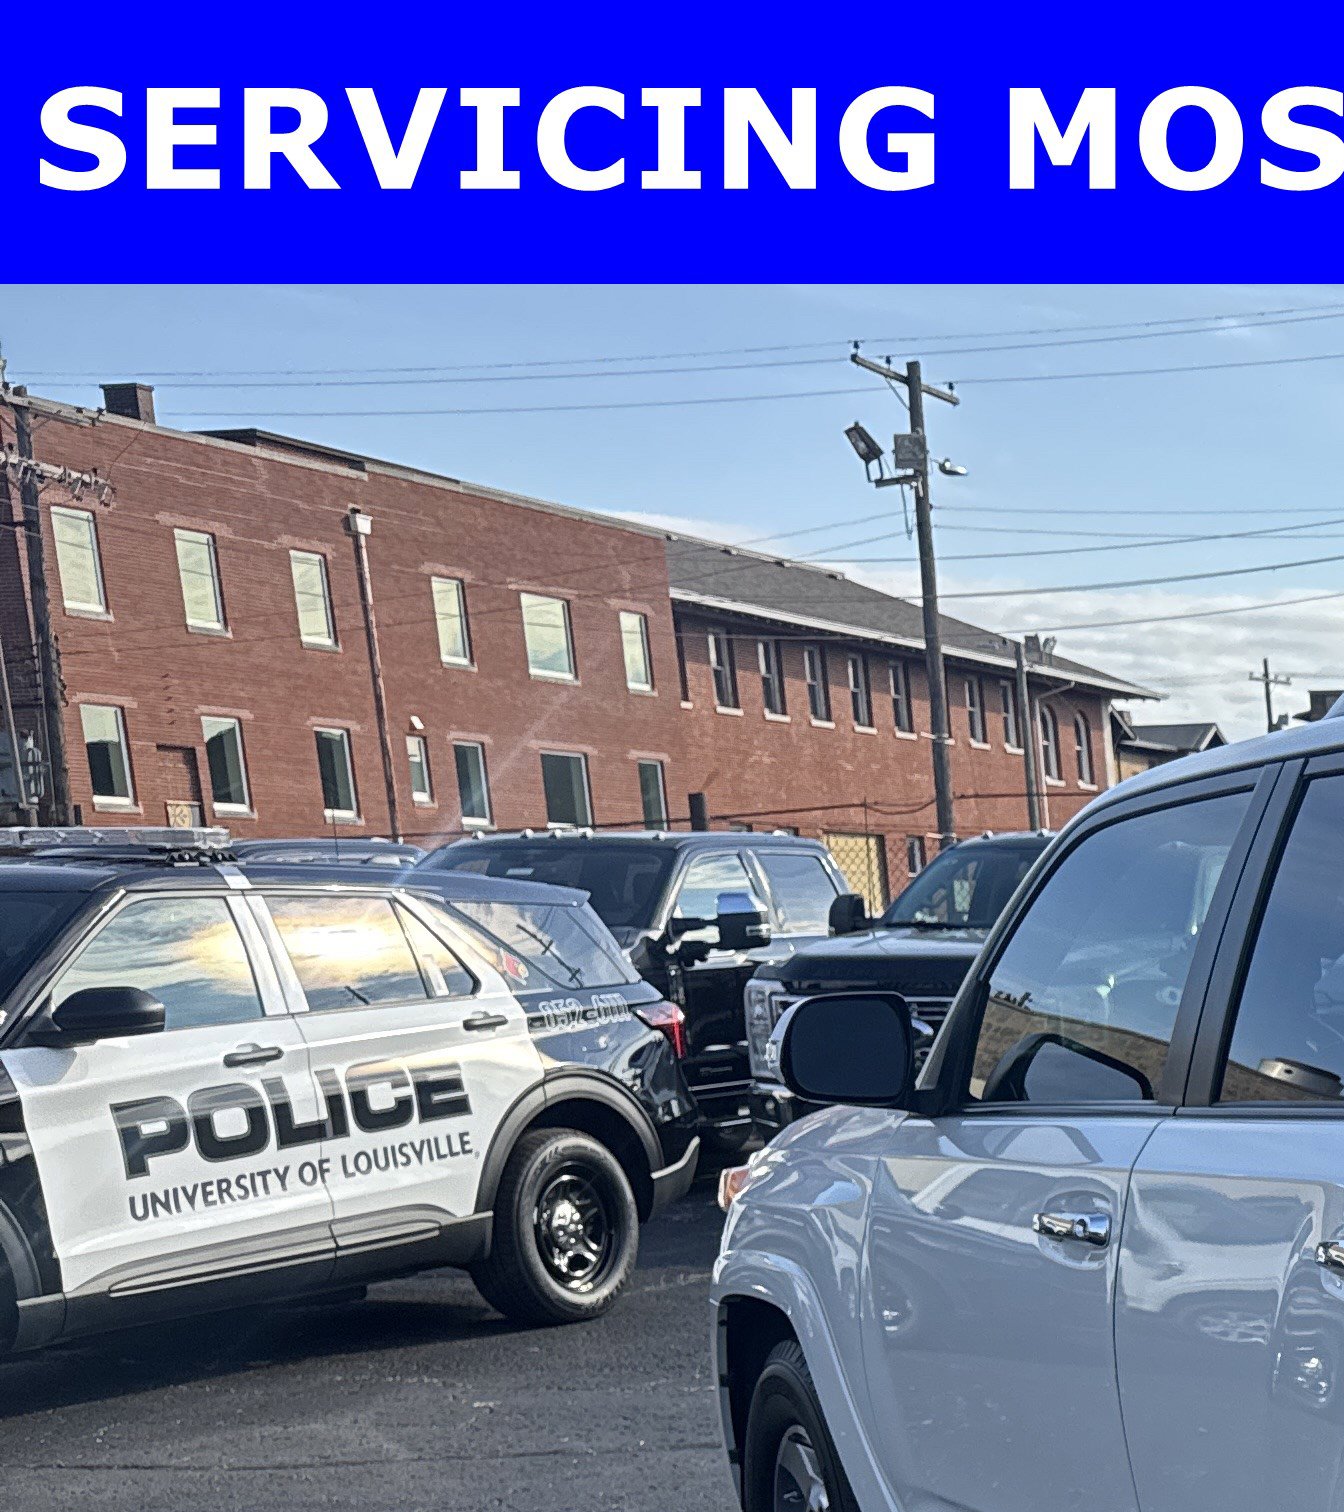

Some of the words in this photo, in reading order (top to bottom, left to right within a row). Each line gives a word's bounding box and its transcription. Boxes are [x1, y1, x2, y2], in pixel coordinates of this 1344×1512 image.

[109, 1059, 474, 1180] POLICE
[128, 1165, 291, 1222] UNIVERSITY
[298, 1156, 331, 1187] OF
[341, 1131, 474, 1179] LOUISVILLE
